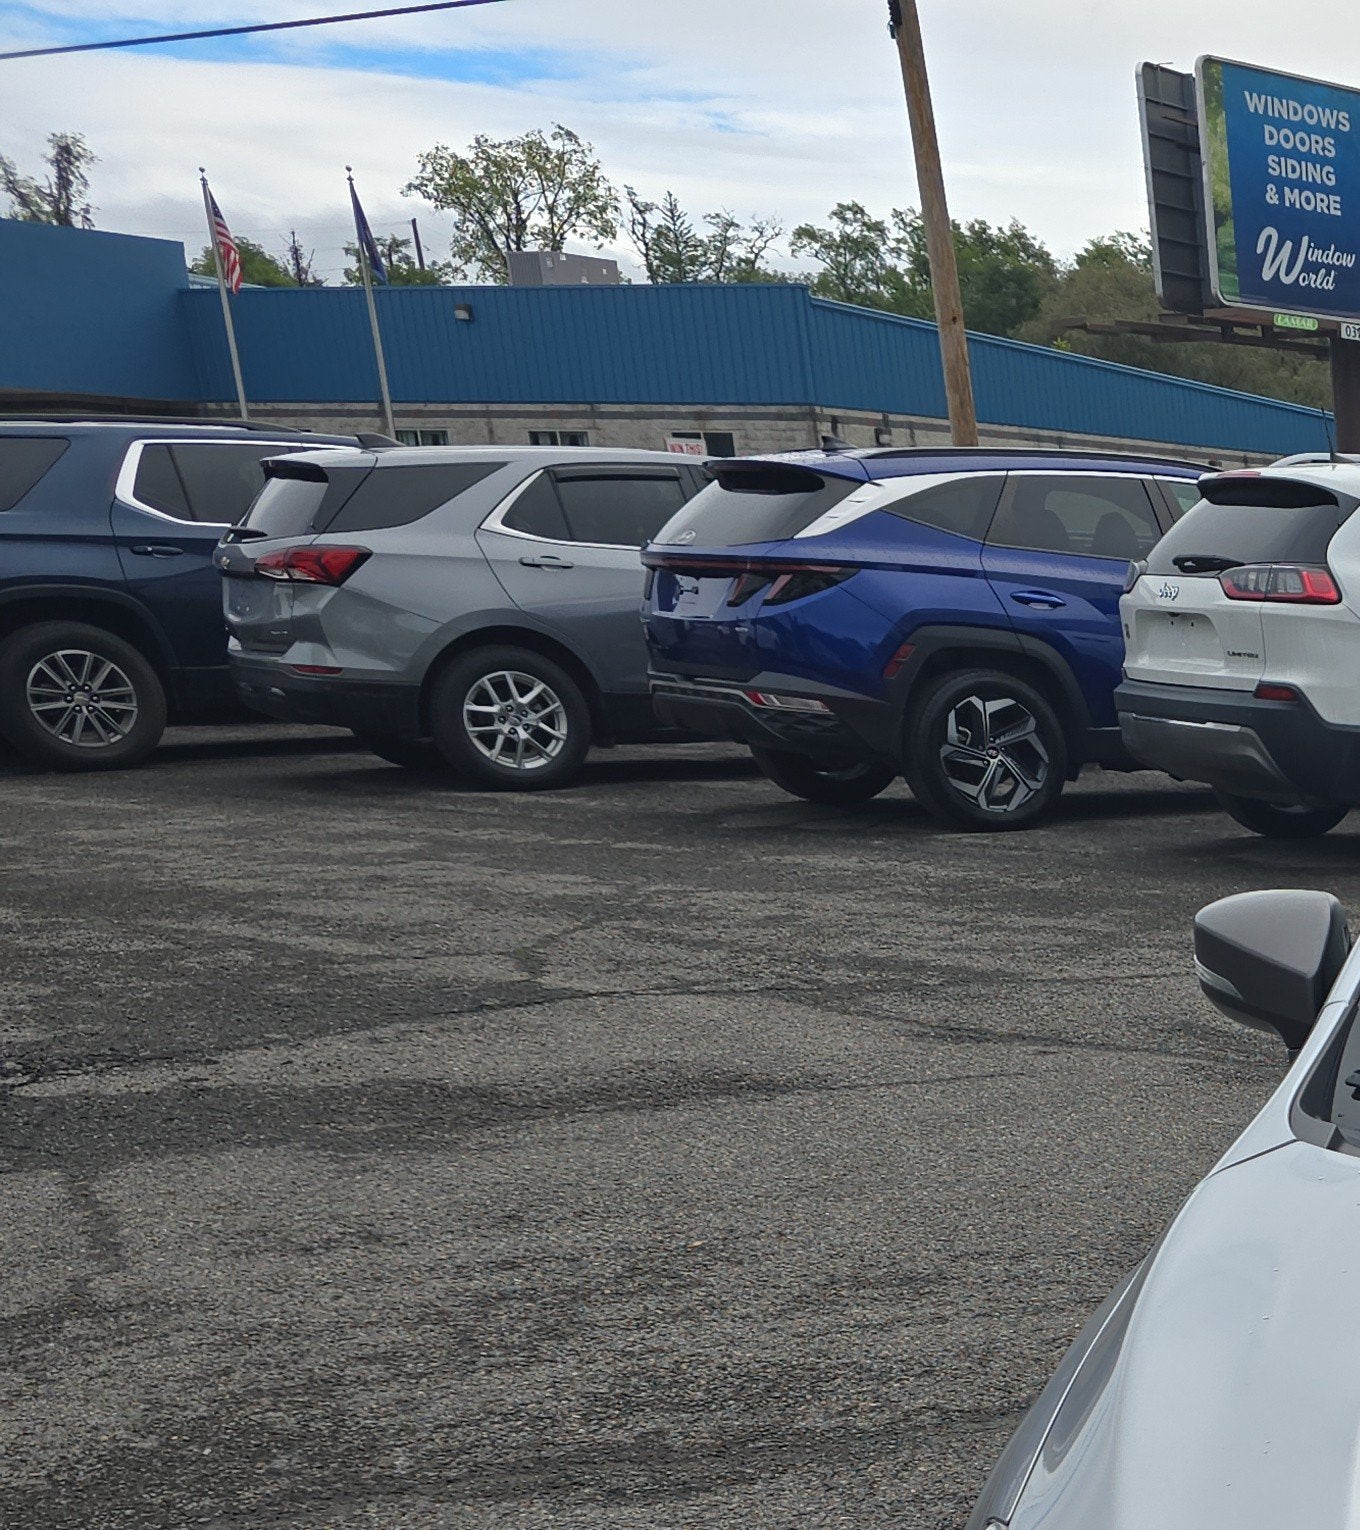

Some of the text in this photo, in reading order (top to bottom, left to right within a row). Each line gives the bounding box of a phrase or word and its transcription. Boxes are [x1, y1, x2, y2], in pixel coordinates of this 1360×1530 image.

[1243, 90, 1351, 132] WINDOWS
[1263, 124, 1336, 158] DOORS
[1267, 154, 1336, 187] SIDING
[1265, 183, 1342, 216] & MORE
[1276, 313, 1315, 329] LAMAR
